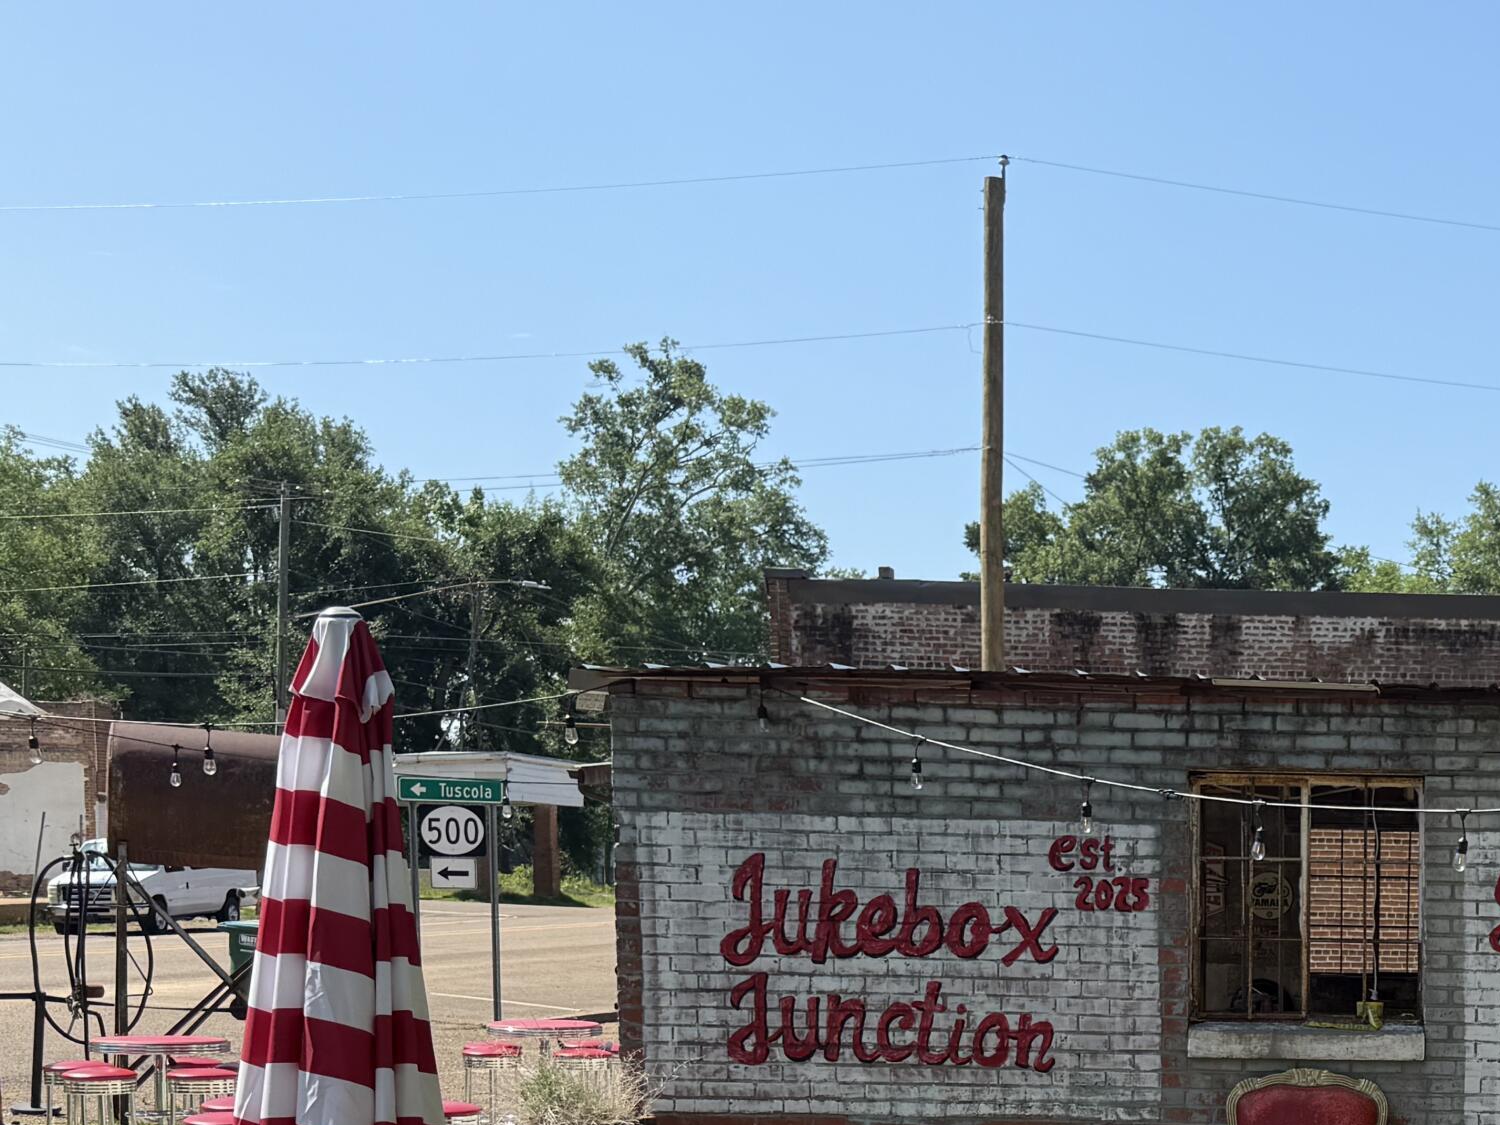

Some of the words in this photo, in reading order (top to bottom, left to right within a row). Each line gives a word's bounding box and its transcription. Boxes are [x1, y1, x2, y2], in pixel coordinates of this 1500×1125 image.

[439, 783, 492, 799] Tuscola
[428, 817, 479, 845] 500
[720, 852, 1059, 967] Jukebox
[1073, 876, 1149, 913] 2025
[726, 972, 1056, 1073] Junction
